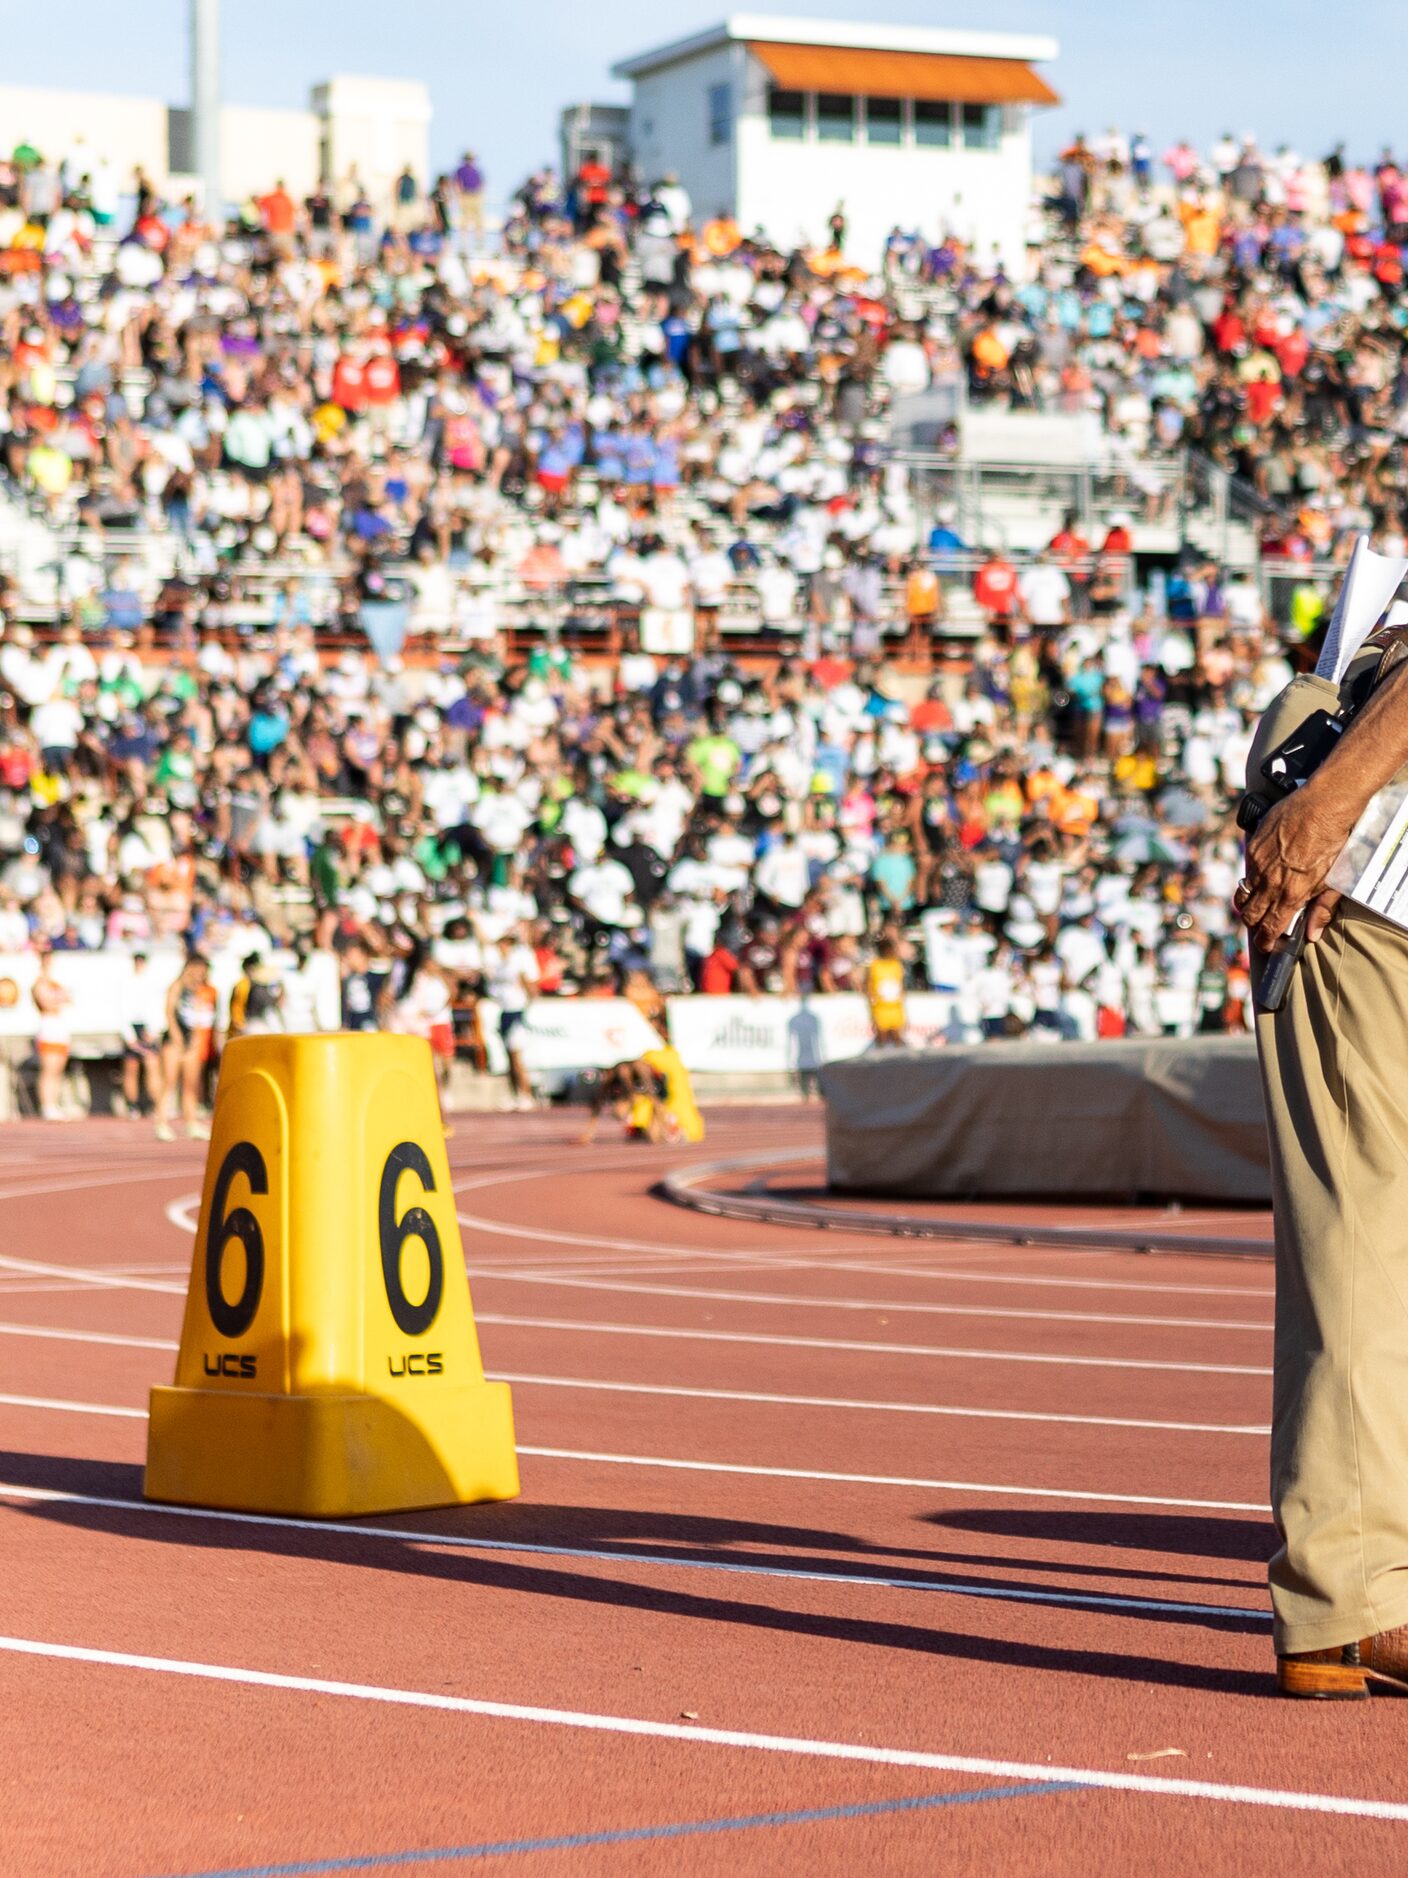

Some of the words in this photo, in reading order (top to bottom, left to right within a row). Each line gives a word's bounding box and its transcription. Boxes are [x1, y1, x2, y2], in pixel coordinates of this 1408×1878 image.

[206, 1141, 269, 1339] 6
[379, 1141, 444, 1338] 6
[204, 1353, 257, 1379] UCS
[389, 1352, 443, 1377] UCS
